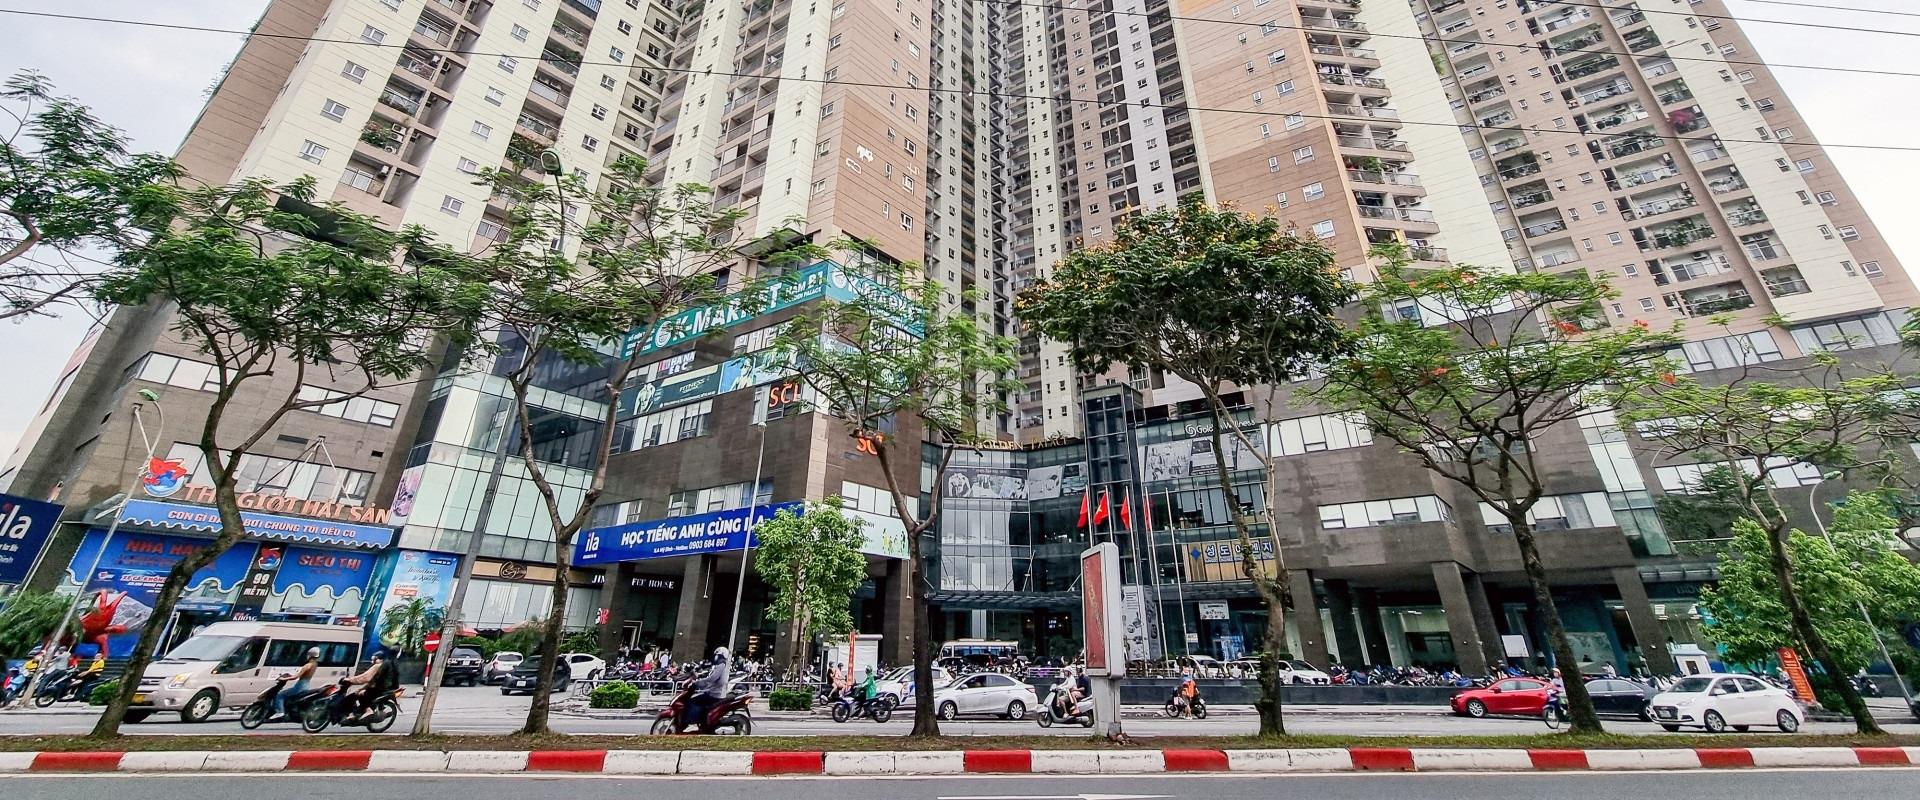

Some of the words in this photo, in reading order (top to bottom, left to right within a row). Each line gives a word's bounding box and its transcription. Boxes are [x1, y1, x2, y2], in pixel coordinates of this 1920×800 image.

[672, 282, 782, 341] K-MARET
[585, 531, 600, 552] ila
[621, 530, 643, 548] HỌC
[646, 522, 678, 543] TIẾNG
[679, 522, 704, 539] ANH
[707, 515, 741, 536] CÙNG
[688, 540, 703, 550] 0903
[253, 572, 270, 585] 99
